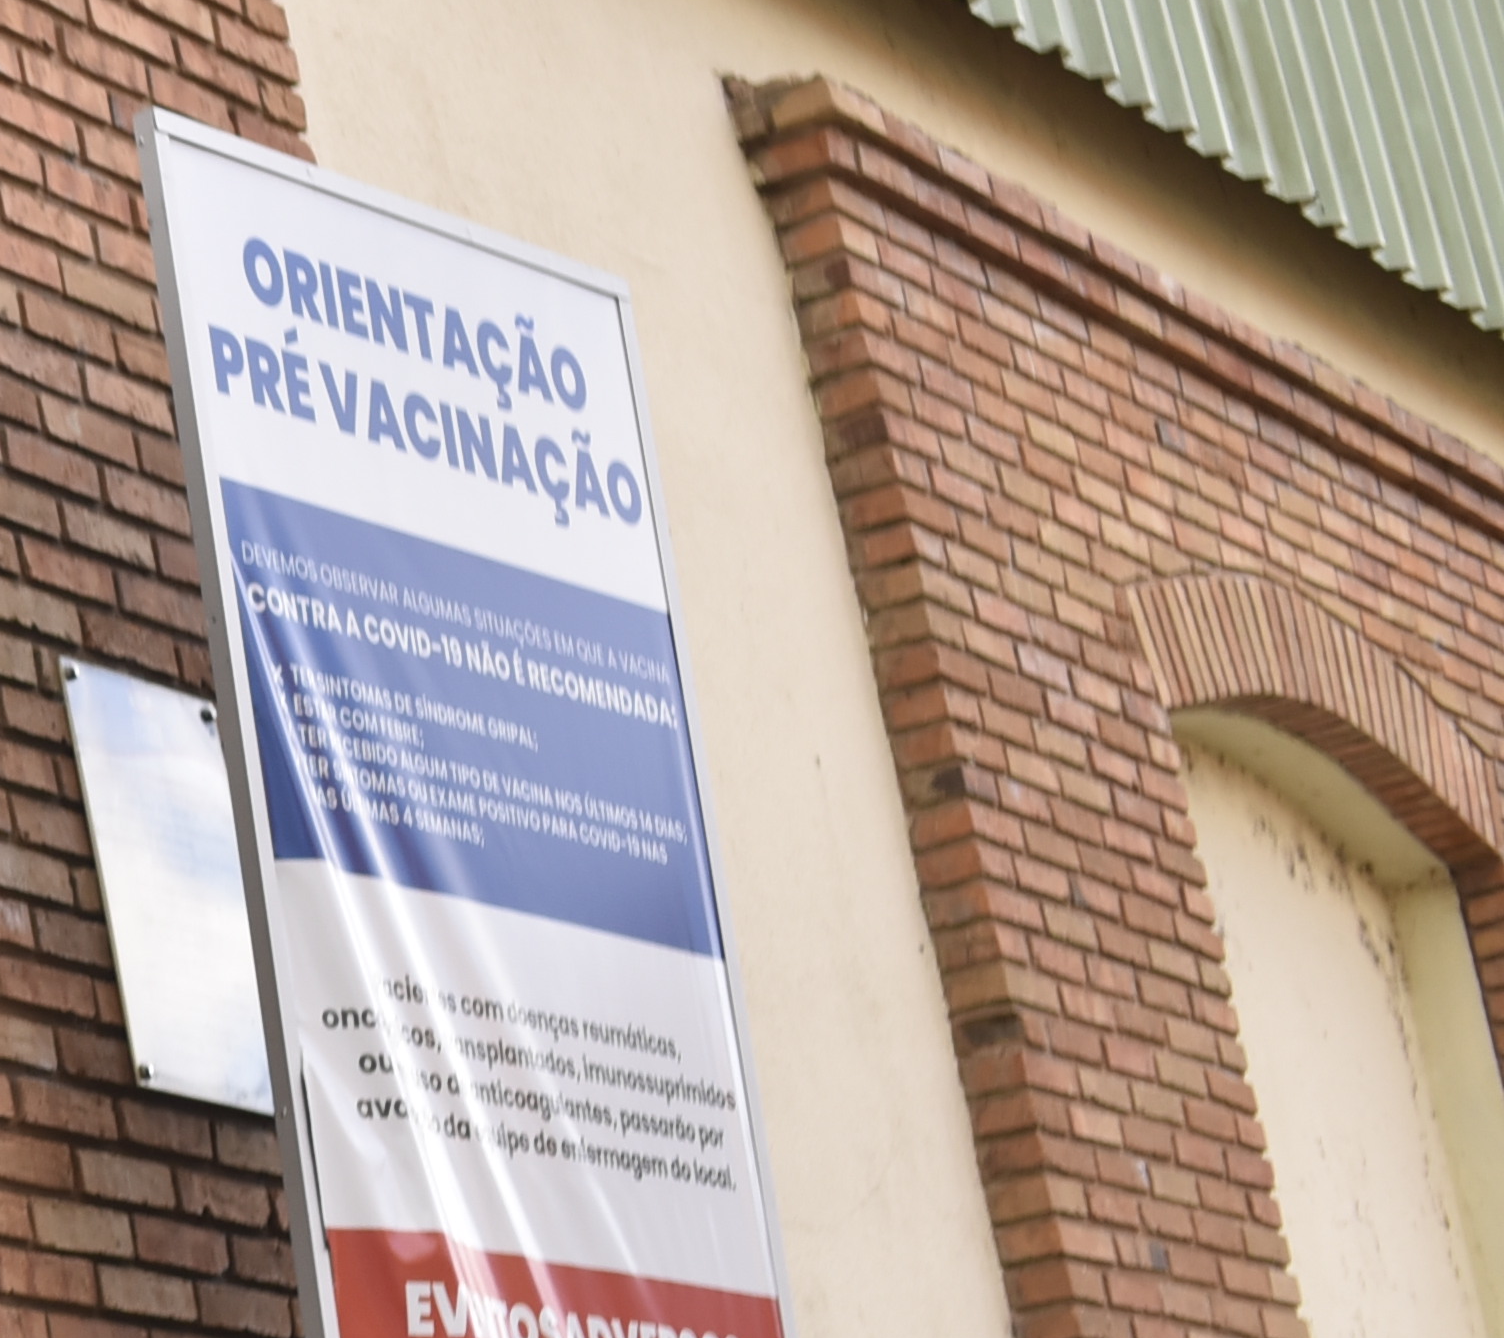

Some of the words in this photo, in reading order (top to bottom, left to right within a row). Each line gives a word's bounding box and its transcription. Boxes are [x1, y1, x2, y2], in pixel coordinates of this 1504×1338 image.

[242, 236, 587, 412] ORIENTAÇÃO
[208, 323, 317, 424] PRÉ
[318, 363, 642, 529] VACINAÇÃO
[242, 540, 317, 581] DEVEMOS
[320, 562, 399, 606] OBSERVAR
[403, 588, 472, 627] ALGUMAS
[474, 606, 552, 651] SITUAÇÕES
[555, 631, 574, 655] EM
[577, 639, 605, 667] QUE
[608, 649, 618, 670] A
[619, 651, 670, 685] VACINA
[247, 582, 342, 634] CONTRA
[347, 611, 361, 639] A
[364, 615, 462, 668] COVID-19
[467, 639, 509, 681] NÃO
[515, 650, 526, 685] É
[530, 657, 678, 729] RECOMENDADA:
[326, 674, 392, 713] SINTOMAS
[394, 695, 413, 716] DE
[416, 694, 485, 737] SÍNDROME
[341, 707, 376, 734] COM
[402, 750, 448, 784] ALGUM
[450, 760, 479, 790] TIPO
[485, 769, 499, 795] DE
[503, 773, 552, 810] VACINA
[555, 787, 582, 814] NOS
[586, 790, 637, 831] ÚLTIMOS
[403, 805, 414, 829] 4
[408, 781, 427, 805] OU
[429, 787, 478, 818] EXAME
[480, 799, 540, 835] POSITIVO
[543, 816, 577, 845] PARA
[580, 824, 640, 858] COVID-19
[461, 995, 504, 1021] com
[507, 998, 580, 1043] doenças
[582, 1018, 682, 1064] reumáticas,
[583, 1054, 736, 1112] imunossuprimidos
[445, 1114, 470, 1141] da
[533, 1128, 558, 1157] de
[671, 1158, 691, 1182] do
[619, 1107, 692, 1145] passarão
[698, 1124, 724, 1152] por
